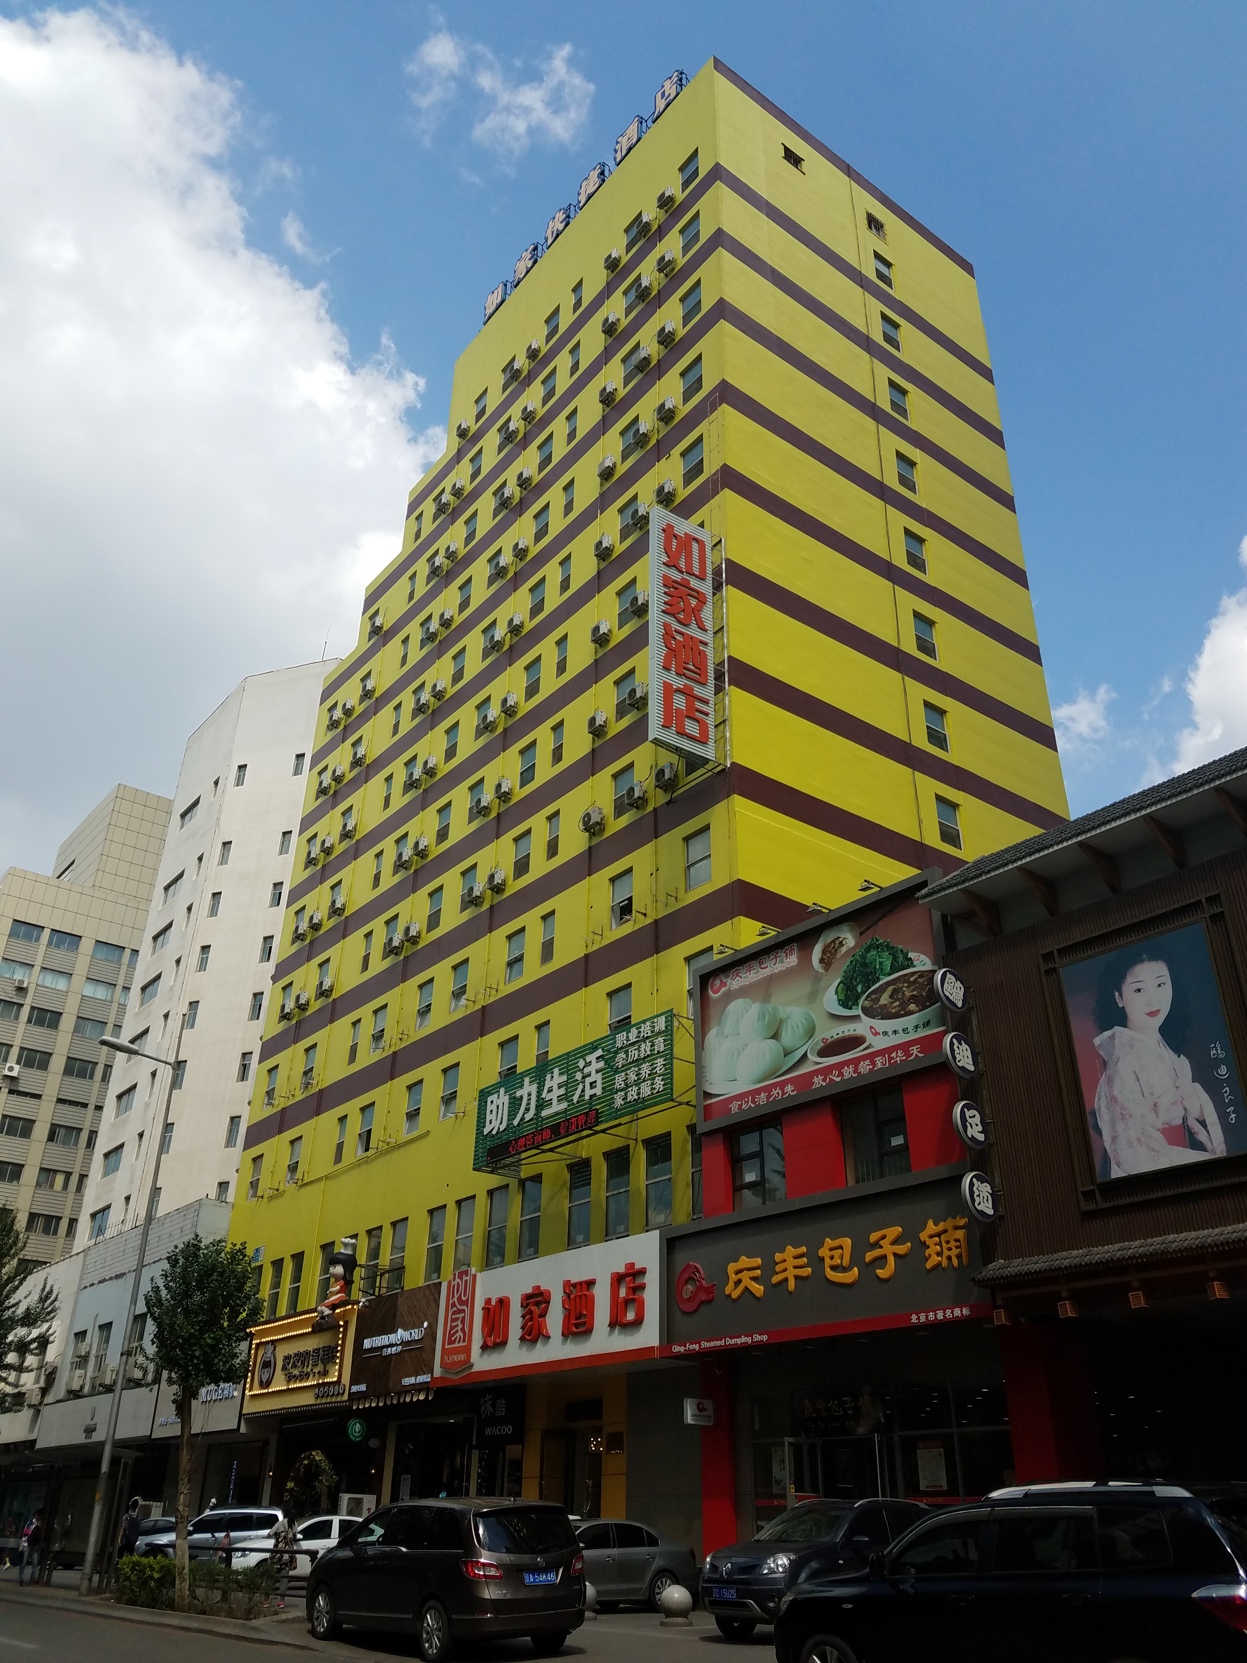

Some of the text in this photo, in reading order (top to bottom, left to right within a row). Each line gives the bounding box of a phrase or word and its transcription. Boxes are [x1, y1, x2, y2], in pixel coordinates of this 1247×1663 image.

[662, 523, 709, 744] 如家酒店
[730, 944, 798, 981] 庆丰包子铺
[615, 1016, 666, 1048] 职业培训
[615, 1037, 665, 1068] 学历教育
[614, 1058, 665, 1090] 居家养老
[728, 1044, 925, 1114] 食以洁为先 放心就餐到华天
[484, 1049, 605, 1135] 助力生活
[613, 1077, 665, 1109] 家政服务
[724, 1215, 970, 1300] 庆丰包子铺
[479, 1262, 647, 1349] 如家酒店
[910, 1306, 971, 1324] 北京市著名商标
[403, 1327, 425, 1342] WORLD
[672, 1333, 768, 1354] Qing-Feng Steamed Dumpling Shop
[485, 1425, 513, 1436] WACOO
